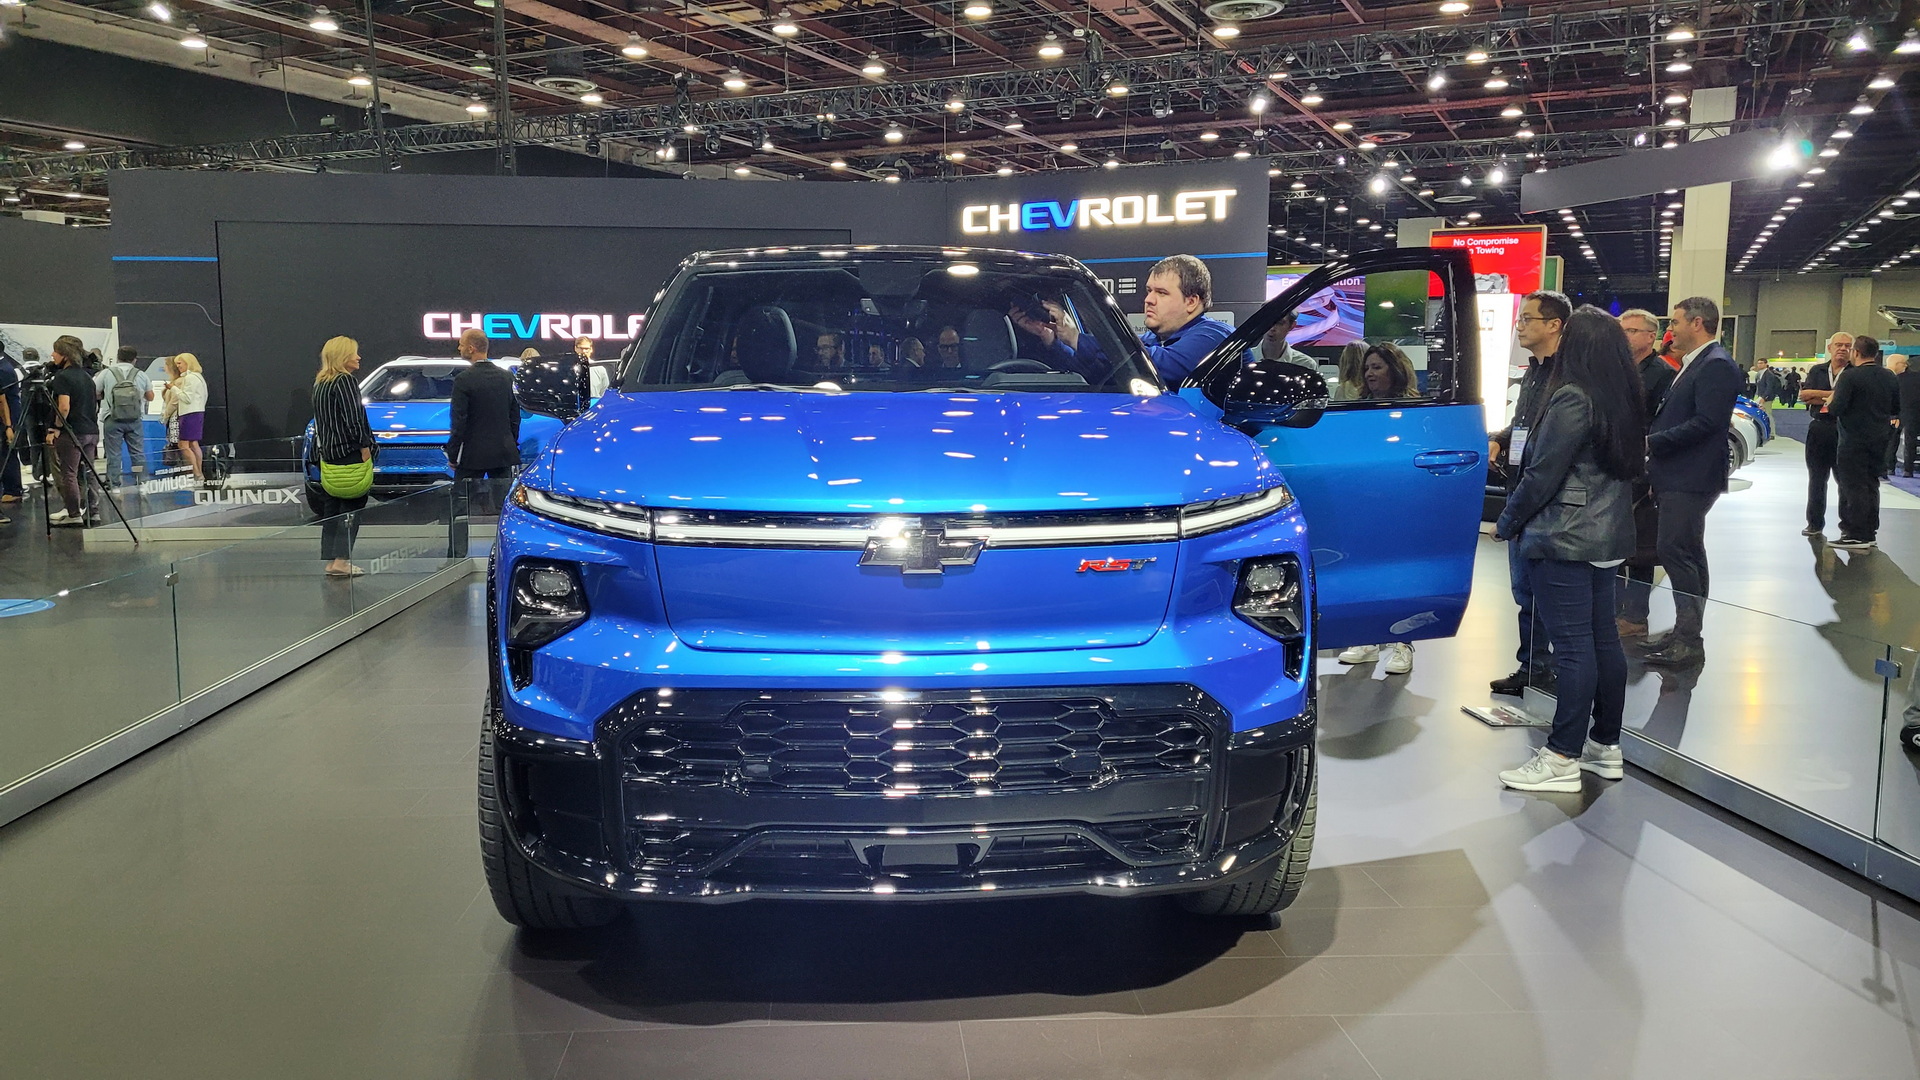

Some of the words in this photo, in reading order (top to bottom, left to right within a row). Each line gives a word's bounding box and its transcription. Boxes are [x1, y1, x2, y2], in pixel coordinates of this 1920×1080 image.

[962, 188, 1237, 233] CHEVROLET
[1467, 237, 1519, 246] Compromise
[1476, 246, 1505, 255] Towing
[422, 312, 646, 340] CHEVROLE
[194, 488, 301, 506] QUINOX
[1075, 556, 1157, 573] RST
